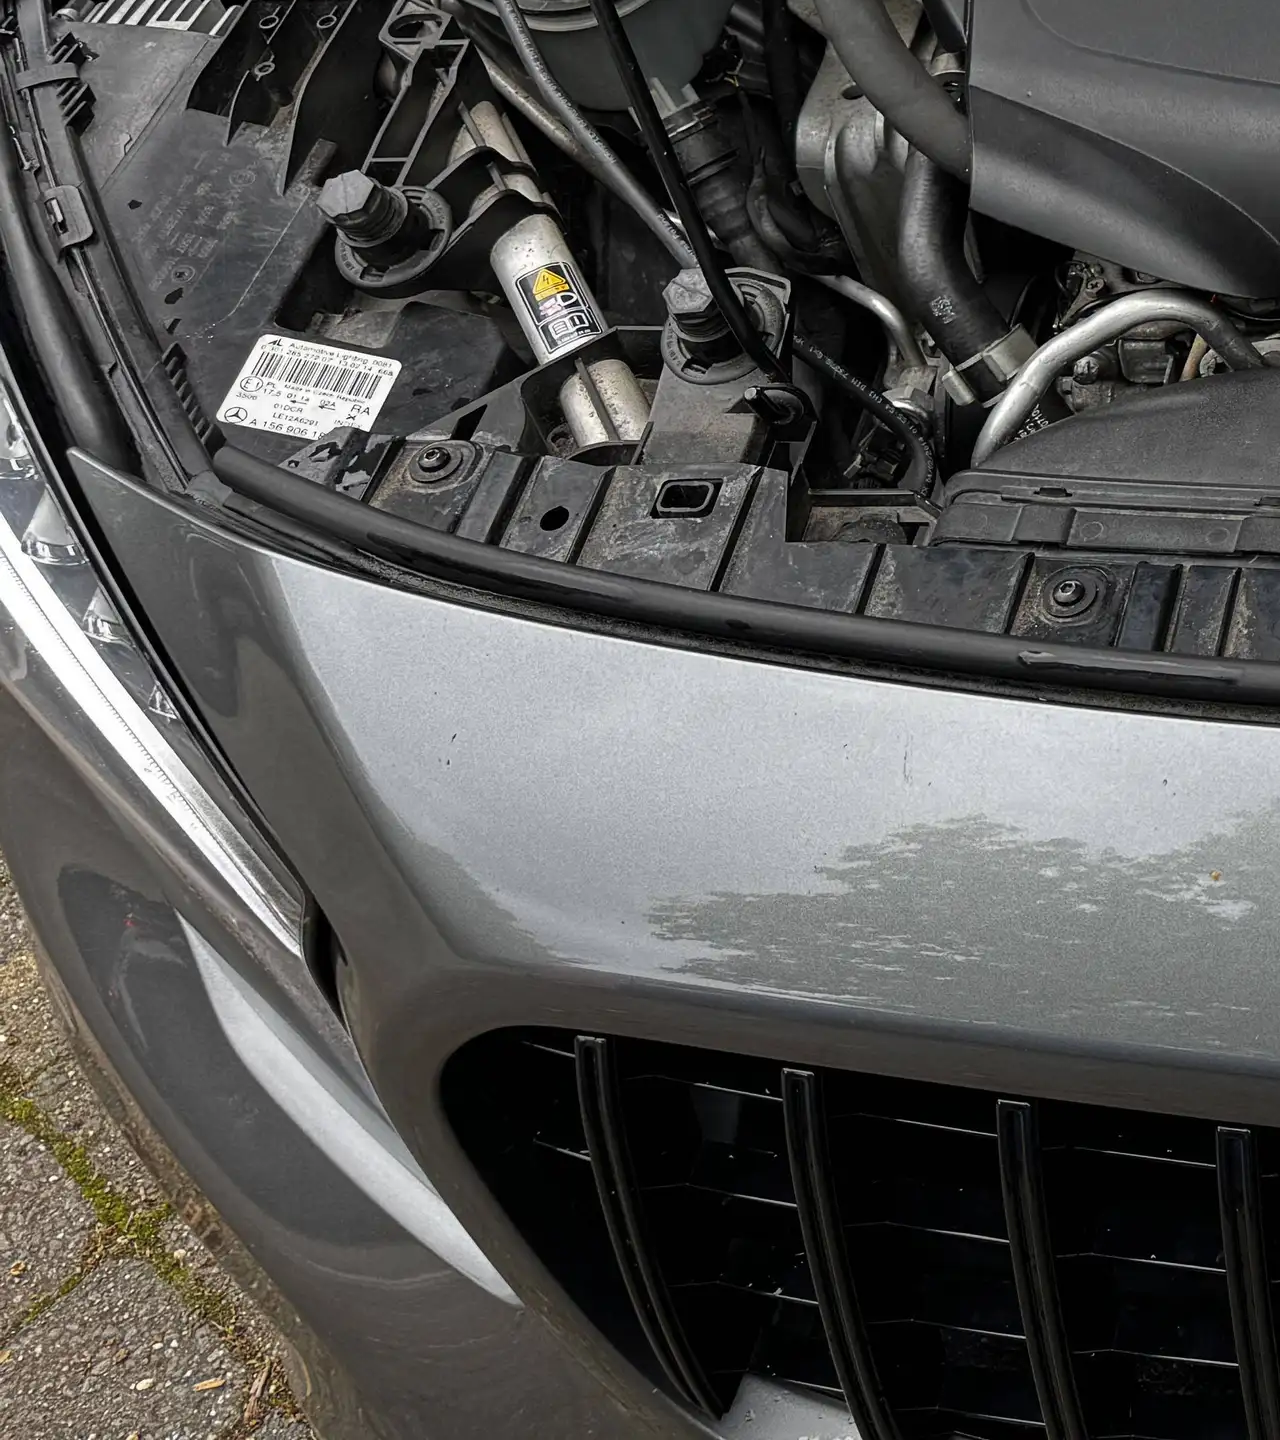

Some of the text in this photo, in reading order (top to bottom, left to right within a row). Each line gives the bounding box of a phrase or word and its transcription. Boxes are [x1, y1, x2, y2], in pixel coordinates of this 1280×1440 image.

[350, 403, 372, 416] RA
[249, 416, 259, 425] A
[261, 419, 284, 430] 156
[285, 425, 308, 436] 906
